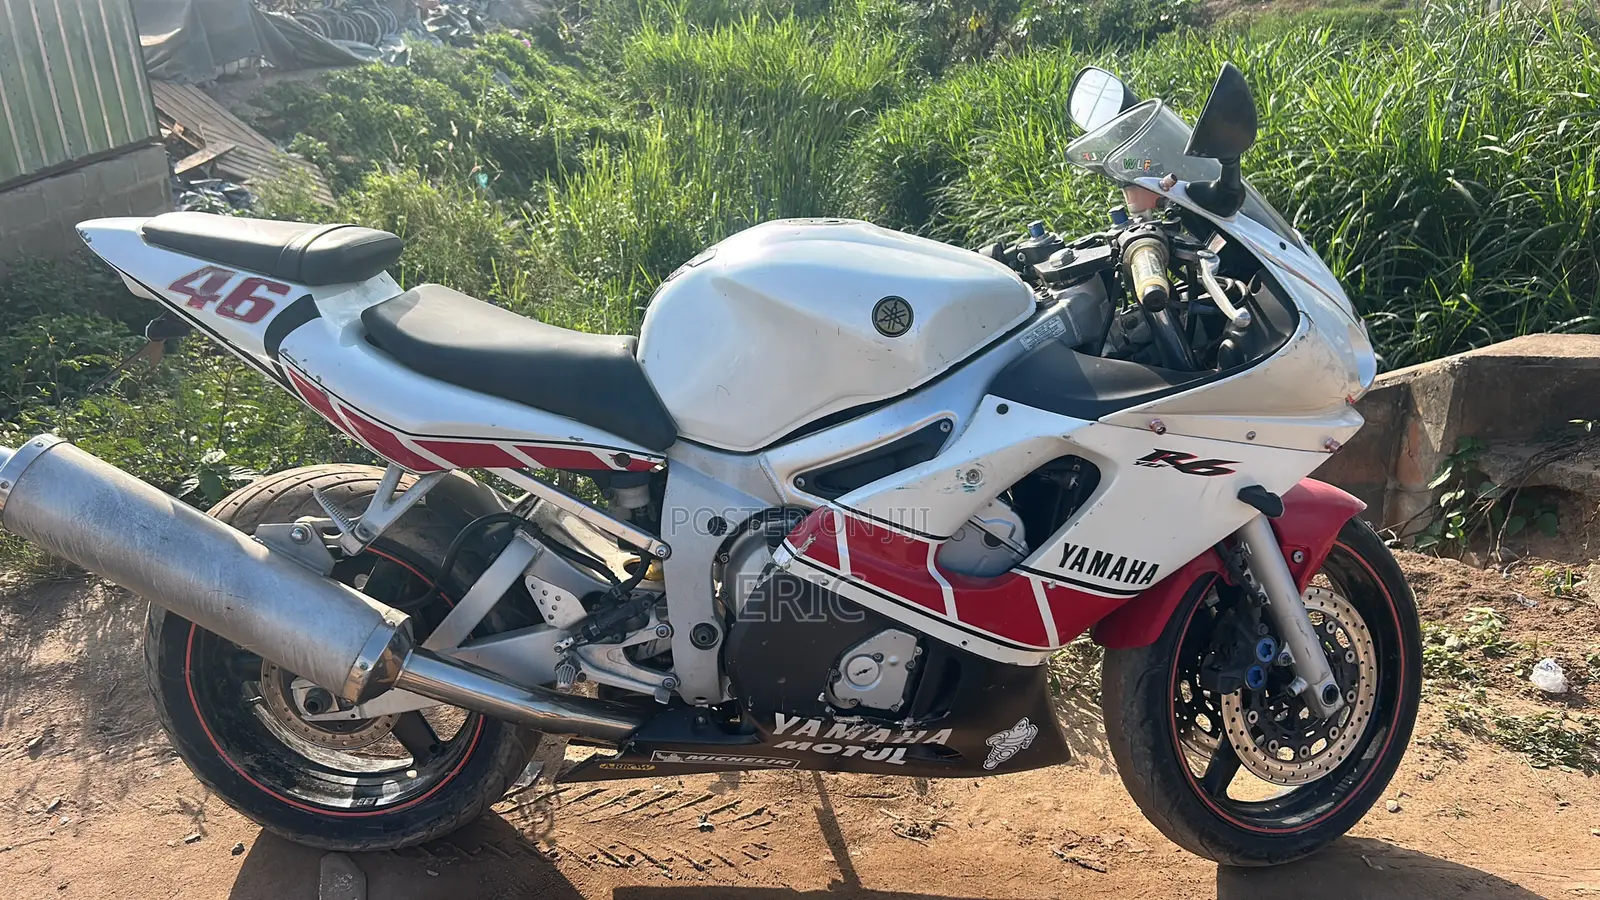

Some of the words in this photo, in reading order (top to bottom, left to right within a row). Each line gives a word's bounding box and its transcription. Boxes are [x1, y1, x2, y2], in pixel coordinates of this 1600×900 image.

[1123, 158, 1152, 172] WLF
[167, 265, 291, 324] 46
[1136, 448, 1243, 477] R6
[1058, 542, 1160, 585] YAMAHA
[772, 712, 953, 745] YAMAHA
[686, 754, 793, 766] MICHELIN
[773, 740, 908, 766] MOTUL
